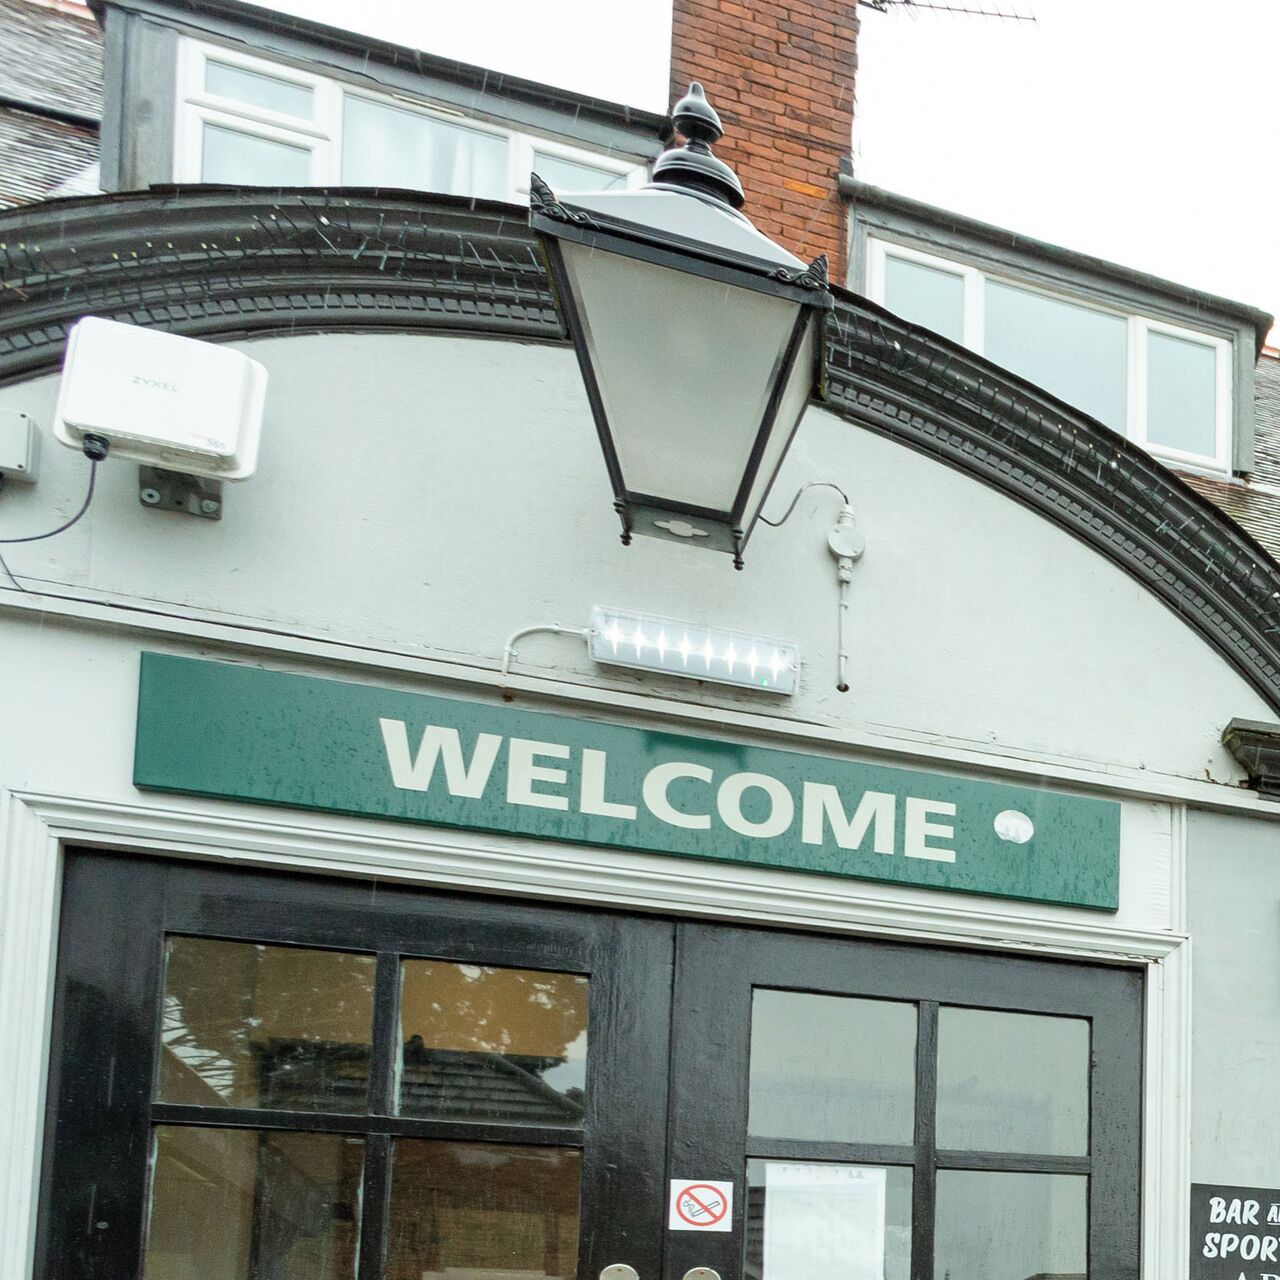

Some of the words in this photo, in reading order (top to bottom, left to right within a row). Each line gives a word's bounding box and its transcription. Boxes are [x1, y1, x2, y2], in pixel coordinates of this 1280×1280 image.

[132, 375, 179, 392] ZYXEL
[379, 718, 956, 863] WELCOME
[1209, 1196, 1260, 1225] BAR
